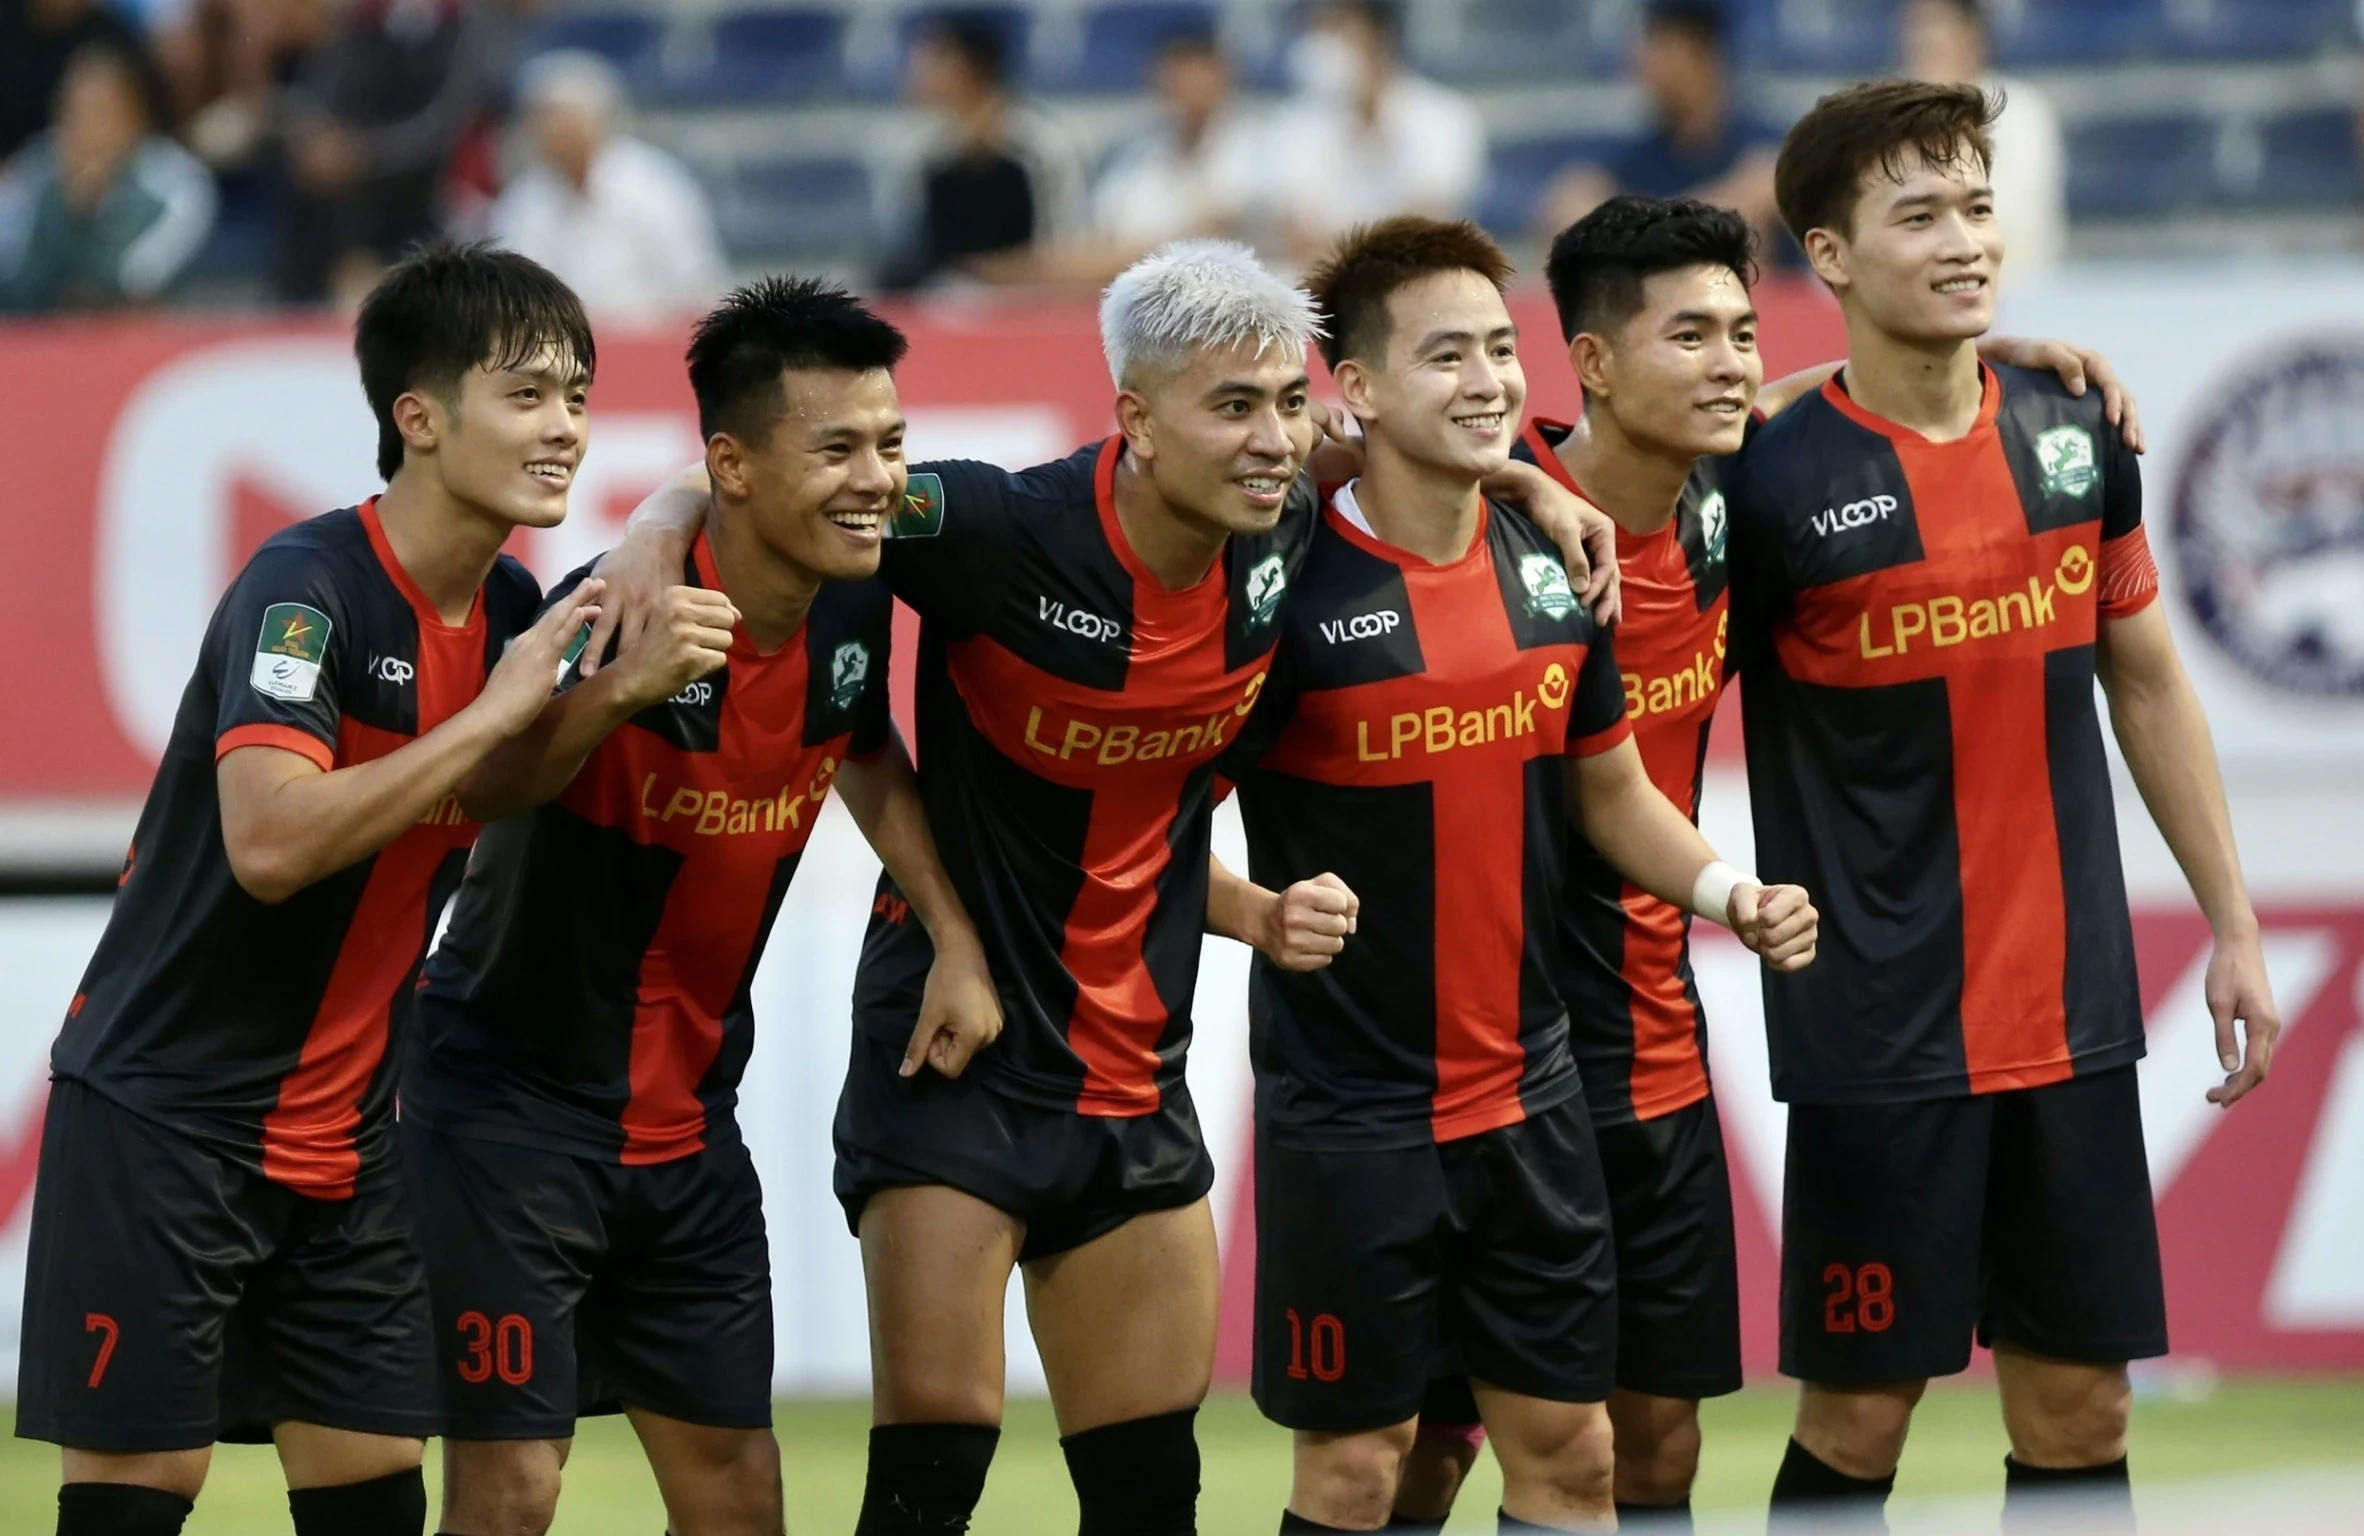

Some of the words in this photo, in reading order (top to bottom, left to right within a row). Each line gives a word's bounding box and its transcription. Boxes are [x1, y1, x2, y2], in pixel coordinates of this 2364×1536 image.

[1811, 495, 1898, 536] VLOOP
[1040, 595, 1121, 643] VLOOP
[1319, 609, 1400, 645] VLOOP
[1860, 576, 2056, 659] LPBank
[1620, 650, 1716, 720] Bank
[1024, 705, 1231, 766] LPBank
[1358, 689, 1538, 762] LPBank
[642, 772, 806, 836] LPBank
[1824, 1263, 1895, 1333] 28
[86, 1312, 119, 1388] 7
[457, 1311, 532, 1386] 30
[1286, 1307, 1345, 1381] 10
